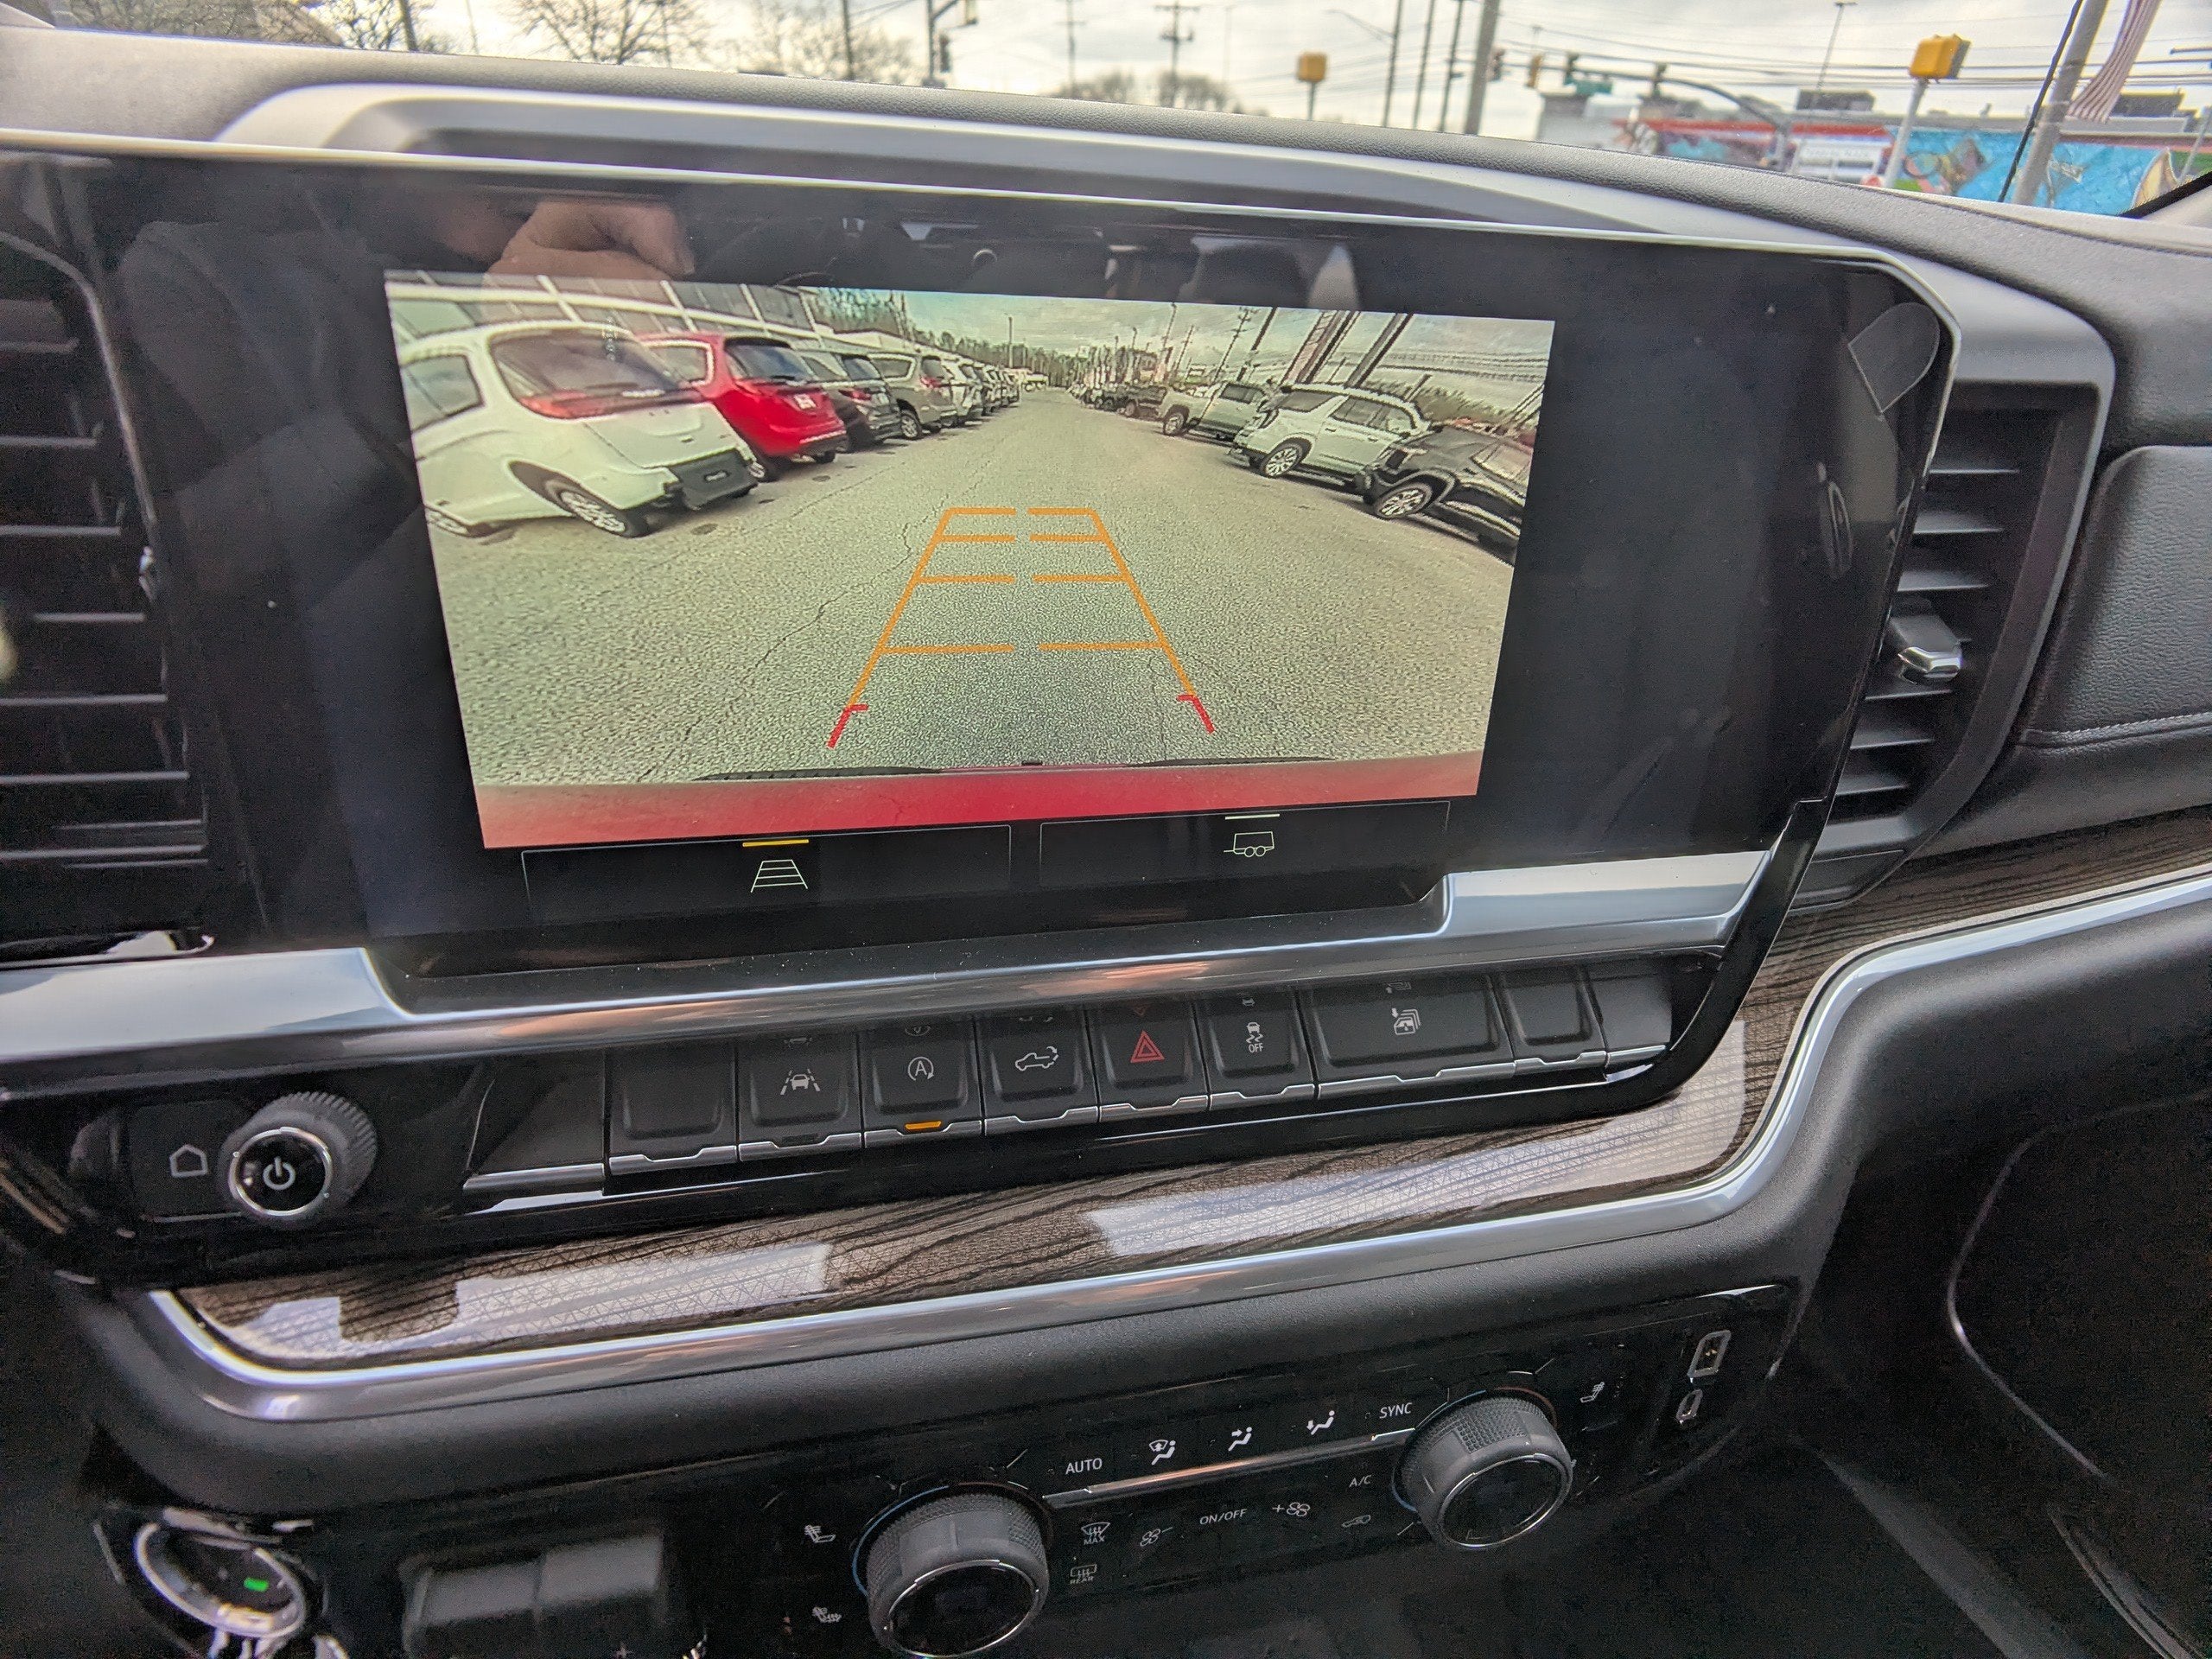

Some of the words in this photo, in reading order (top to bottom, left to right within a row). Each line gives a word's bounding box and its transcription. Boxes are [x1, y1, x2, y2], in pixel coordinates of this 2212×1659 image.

[1249, 1043, 1263, 1053] OFF
[915, 1060, 927, 1077] A
[1379, 1402, 1413, 1419] SYNC
[1065, 1458, 1103, 1475] AUTO
[1349, 1475, 1372, 1488] A/C
[1199, 1508, 1248, 1525] ON/OFF
[1084, 1535, 1105, 1546] MAX
[1070, 1575, 1094, 1585] REAR
